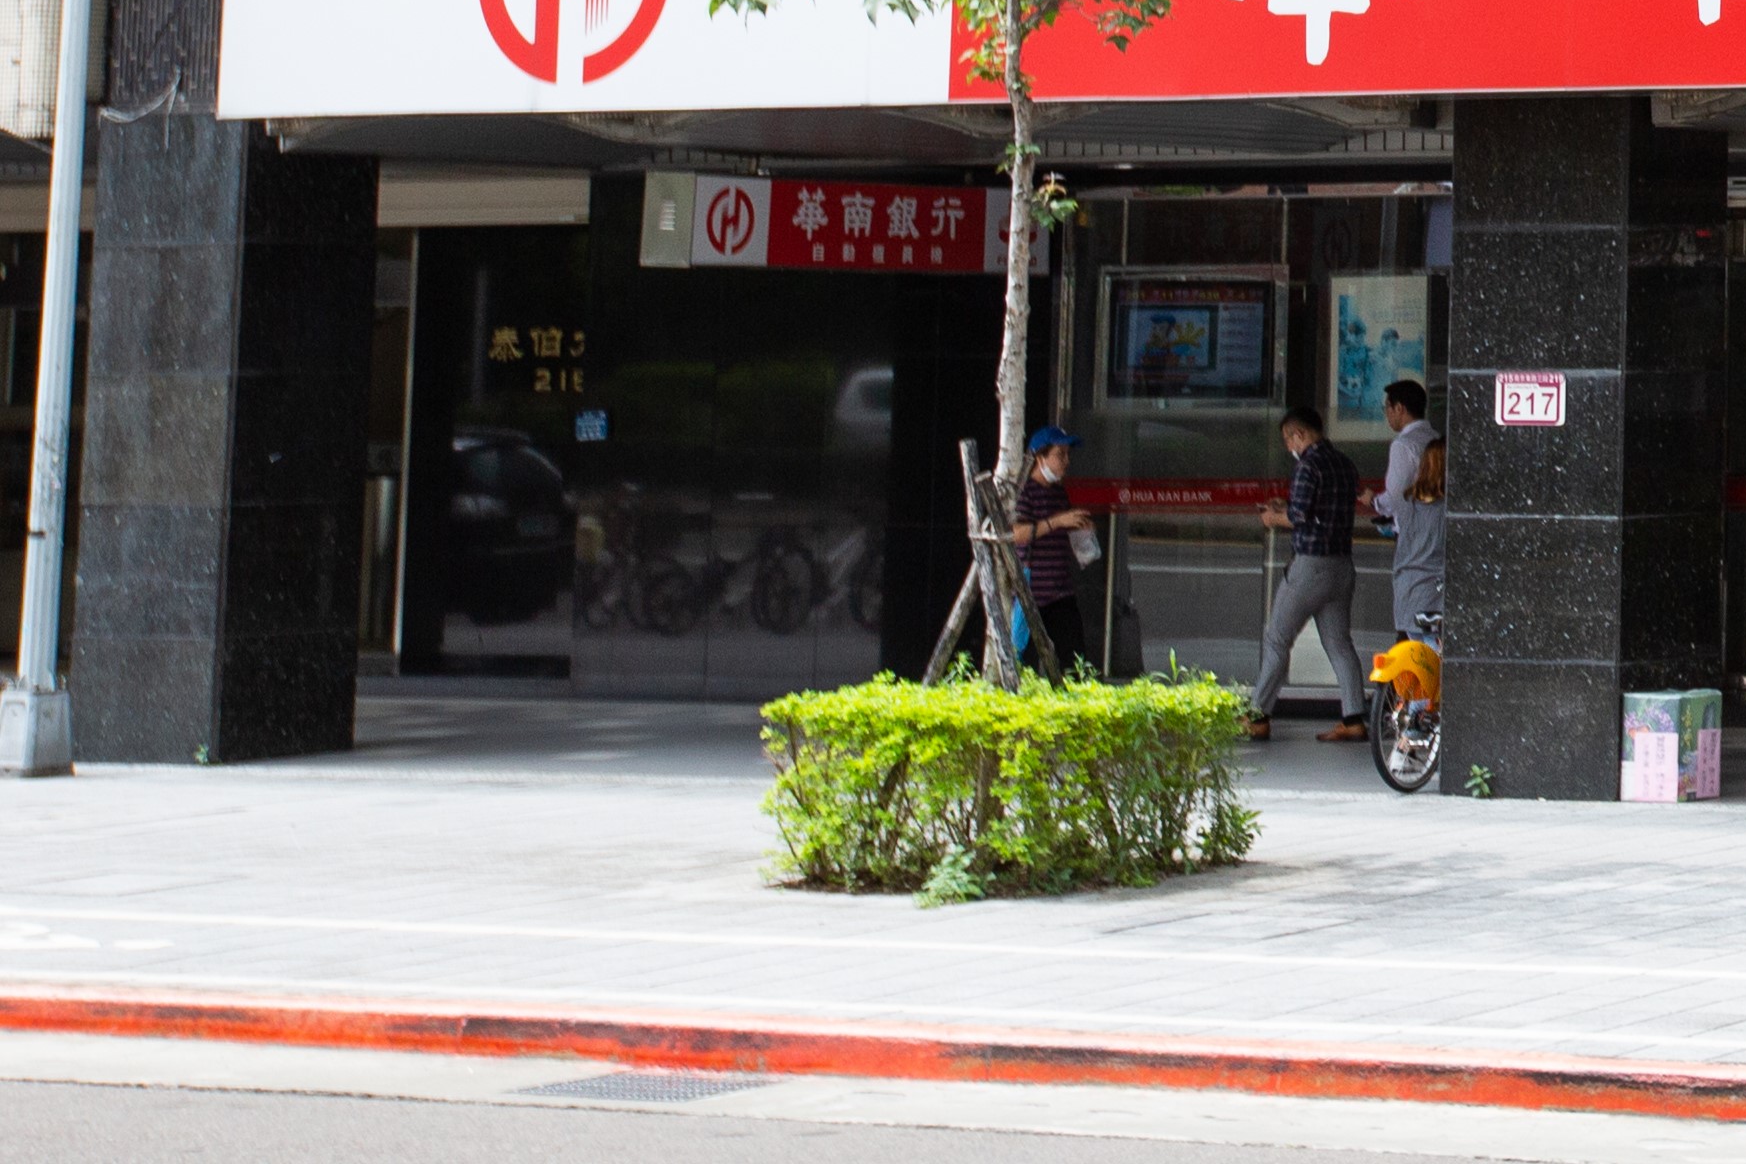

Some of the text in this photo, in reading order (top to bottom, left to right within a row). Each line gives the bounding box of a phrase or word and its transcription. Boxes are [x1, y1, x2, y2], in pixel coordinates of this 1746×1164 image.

[792, 185, 965, 240] 華南銀行
[1508, 392, 1554, 415] 217
[1132, 490, 1212, 502] HUA NAN BANK
